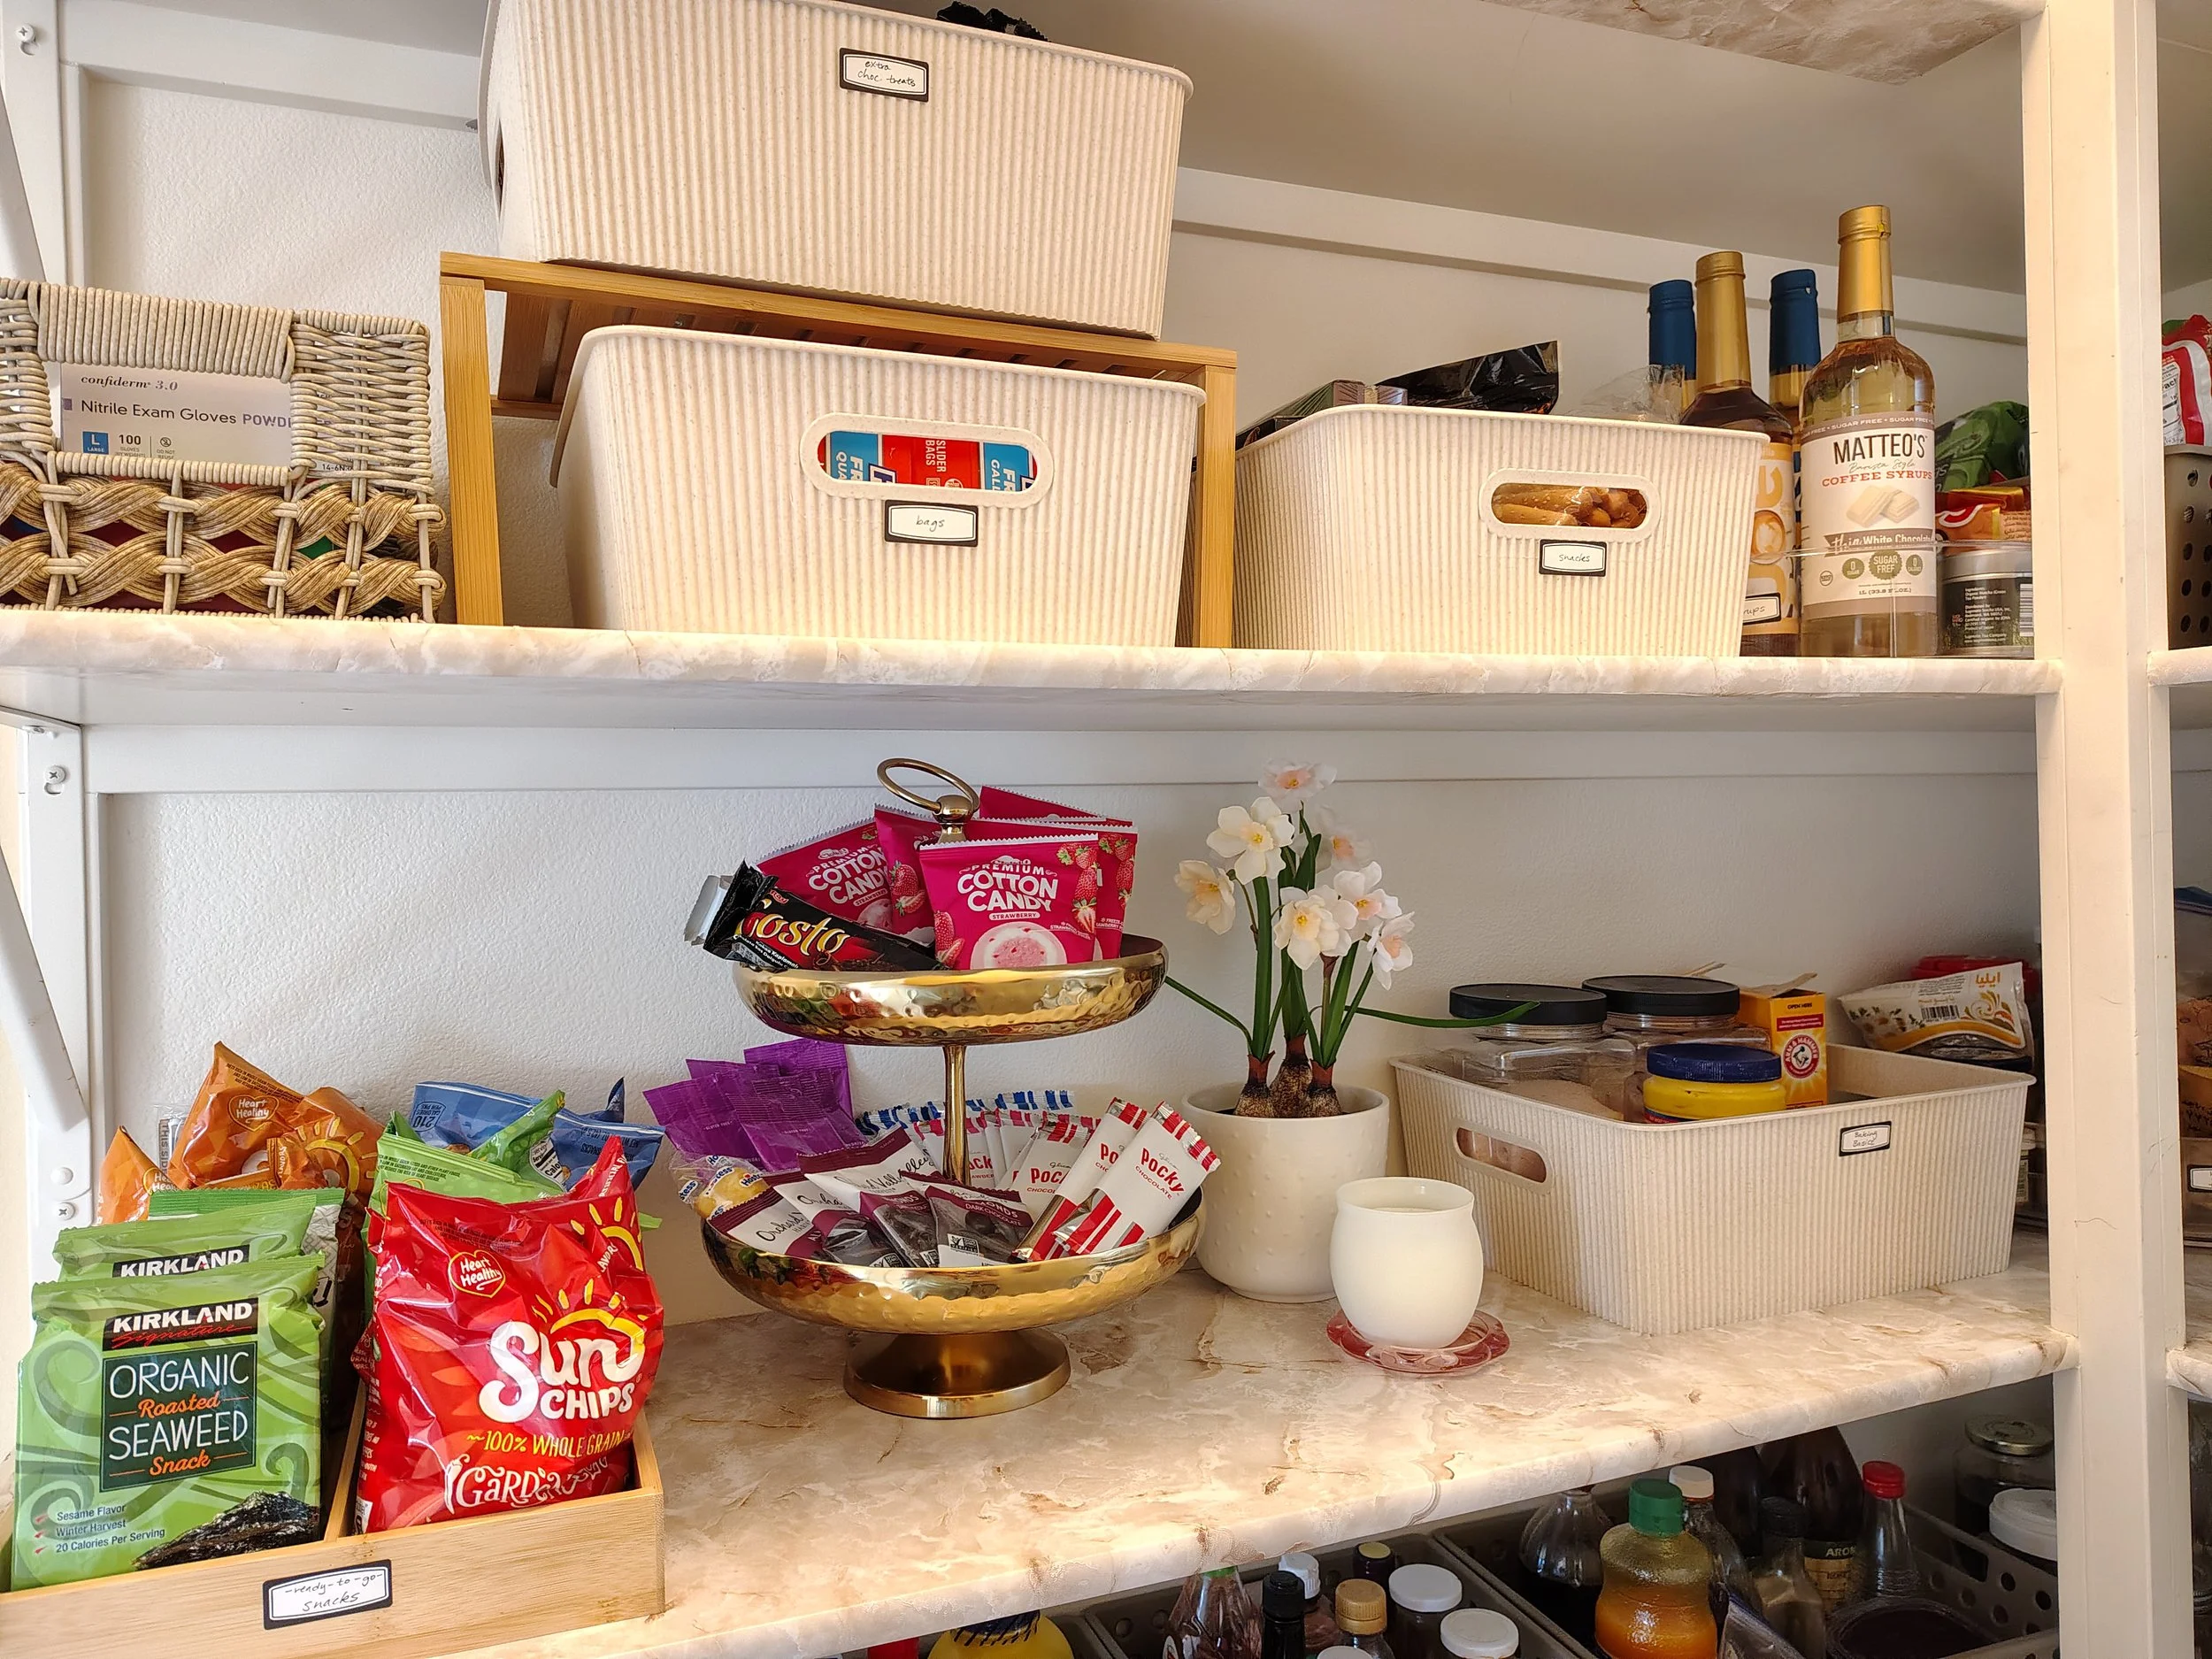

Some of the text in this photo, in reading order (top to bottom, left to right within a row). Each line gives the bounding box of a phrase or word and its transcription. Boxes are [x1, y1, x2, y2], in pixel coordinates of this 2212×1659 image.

[857, 69, 916, 87] choc treats
[865, 61, 890, 71] extra
[155, 380, 178, 391] 3.0
[81, 400, 127, 416] Nitrile
[133, 404, 175, 419] Exam
[180, 408, 236, 424] Gloves
[91, 434, 100, 445] L
[119, 434, 142, 445] 100
[1833, 434, 1926, 465] MATTEO'S
[925, 439, 935, 466] BAGS
[936, 439, 947, 473] SLIDER
[1822, 471, 1932, 487] COFFEE SYRUPS
[916, 515, 945, 532] bags
[1863, 535, 1893, 545] White
[1873, 556, 1898, 565] SUGAR
[809, 848, 887, 890] COTTON
[813, 847, 868, 872] PREMIUM
[972, 864, 1044, 875] PREMIUM
[957, 871, 1058, 899] COTTON
[967, 891, 1051, 911] CANDY
[1797, 1037, 1818, 1059] HAMMER
[238, 1098, 267, 1109] Heart
[412, 1115, 434, 1128] 210
[160, 1124, 169, 1148] THIS
[1135, 1165, 1172, 1200] CHOCOLATE
[1141, 1147, 1185, 1194] Pocky
[756, 1216, 803, 1241] Orchard
[120, 1249, 244, 1278] KIRKLAND
[460, 1256, 490, 1274] Heart
[460, 1269, 503, 1290] Healthy
[112, 1302, 253, 1333] KIRKLAND
[111, 1324, 252, 1349] Signature
[110, 1352, 250, 1399] ORGANIC
[479, 1321, 646, 1424] Sun
[138, 1390, 222, 1419] Roasted
[540, 1383, 635, 1420] CHIPS
[109, 1410, 248, 1460] SEAWEED
[533, 1432, 584, 1458] WHOLE
[149, 1449, 211, 1476] Snack
[57, 1504, 126, 1521] Sesame Flavor
[56, 1520, 126, 1537] Winter Harvest
[56, 1528, 165, 1553] 20 Calories Per Serving
